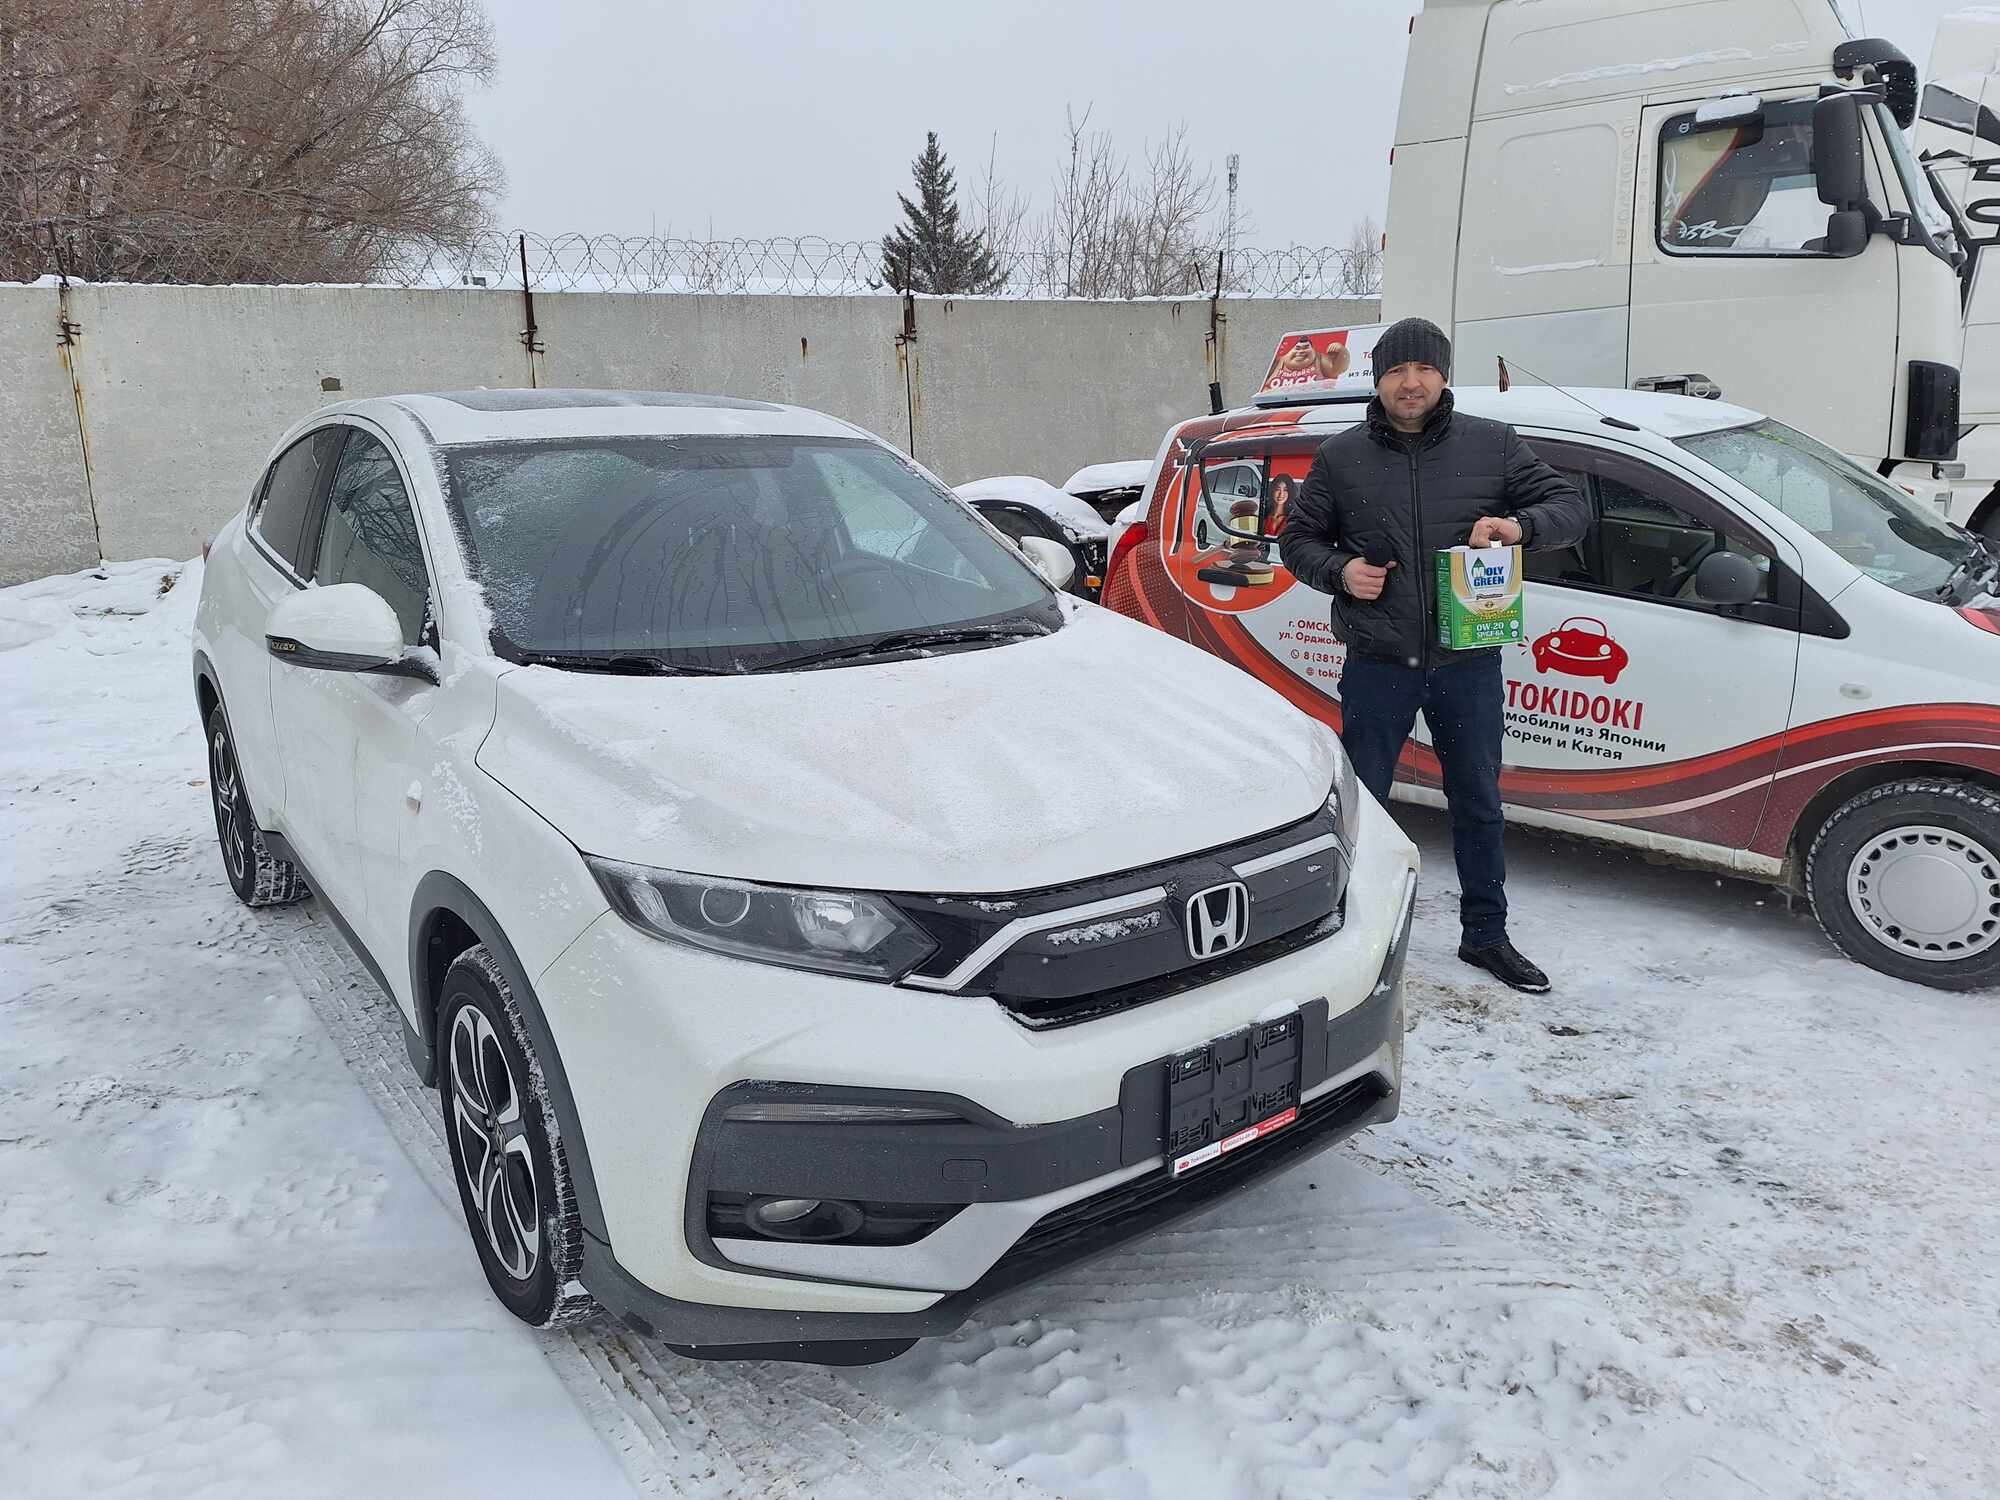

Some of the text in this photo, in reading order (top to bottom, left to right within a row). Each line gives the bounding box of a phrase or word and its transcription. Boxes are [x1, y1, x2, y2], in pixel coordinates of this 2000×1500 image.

[1270, 374, 1317, 388] ОМСК
[1472, 566, 1504, 578] MOLY
[1473, 575, 1505, 587] GREEN
[1288, 620, 1295, 628] г.
[1476, 622, 1505, 632] 0W-20
[1279, 631, 1293, 640] ул.
[1505, 679, 1645, 731] TOKIDOKI
[1504, 711, 1666, 752] мобили из Японии
[1503, 724, 1623, 761] Кореи и Китая
